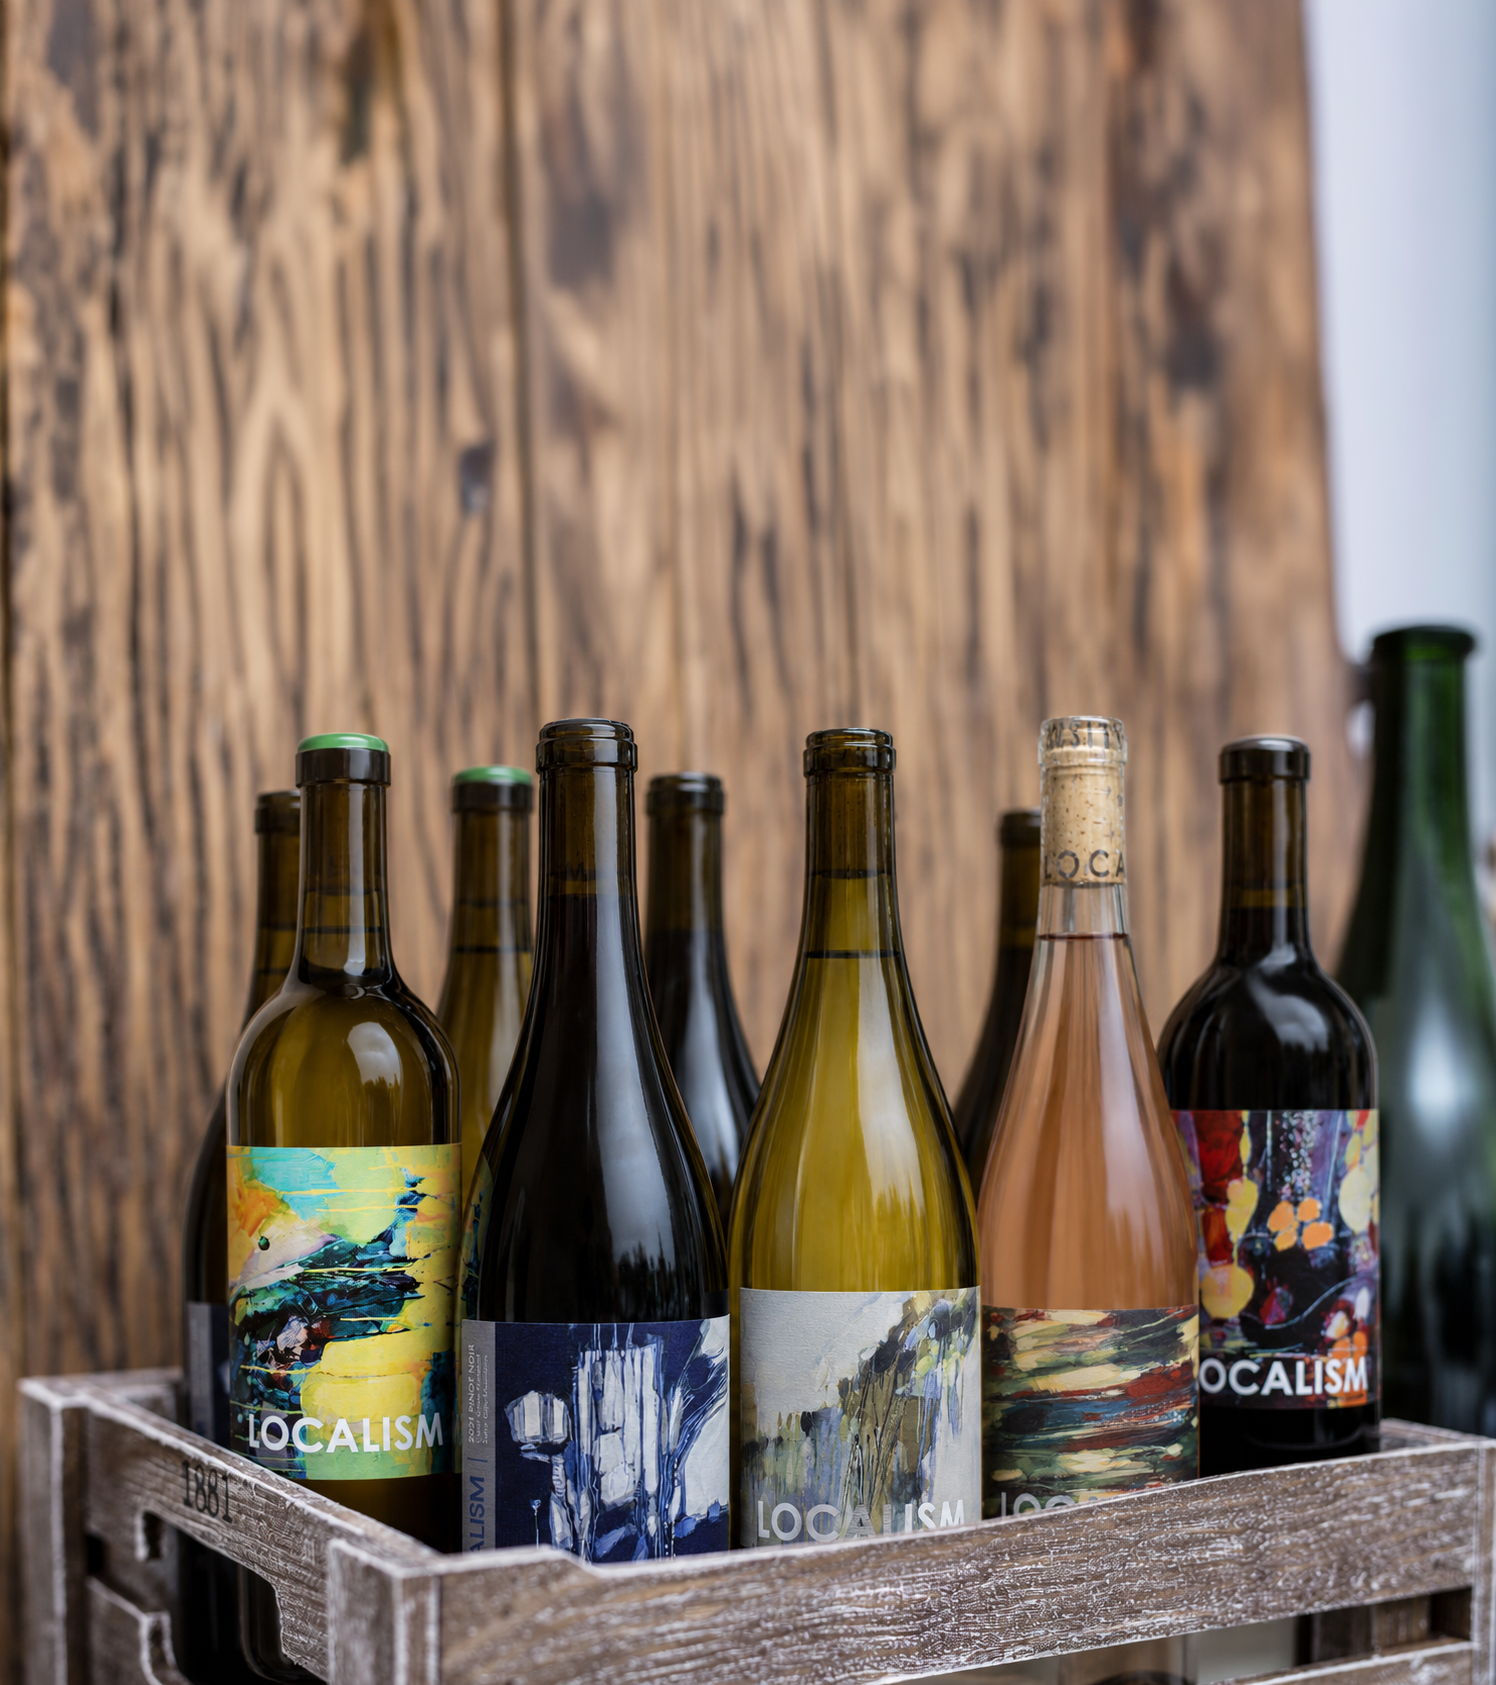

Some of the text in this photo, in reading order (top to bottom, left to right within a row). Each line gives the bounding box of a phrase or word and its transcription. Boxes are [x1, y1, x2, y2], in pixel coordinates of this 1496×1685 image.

[467, 1344, 475, 1374] NOIR
[467, 1376, 475, 1413] PINOT
[249, 1412, 444, 1453] LOCALISM
[182, 1460, 233, 1524] 1881
[757, 1500, 965, 1543] LOCALISM
